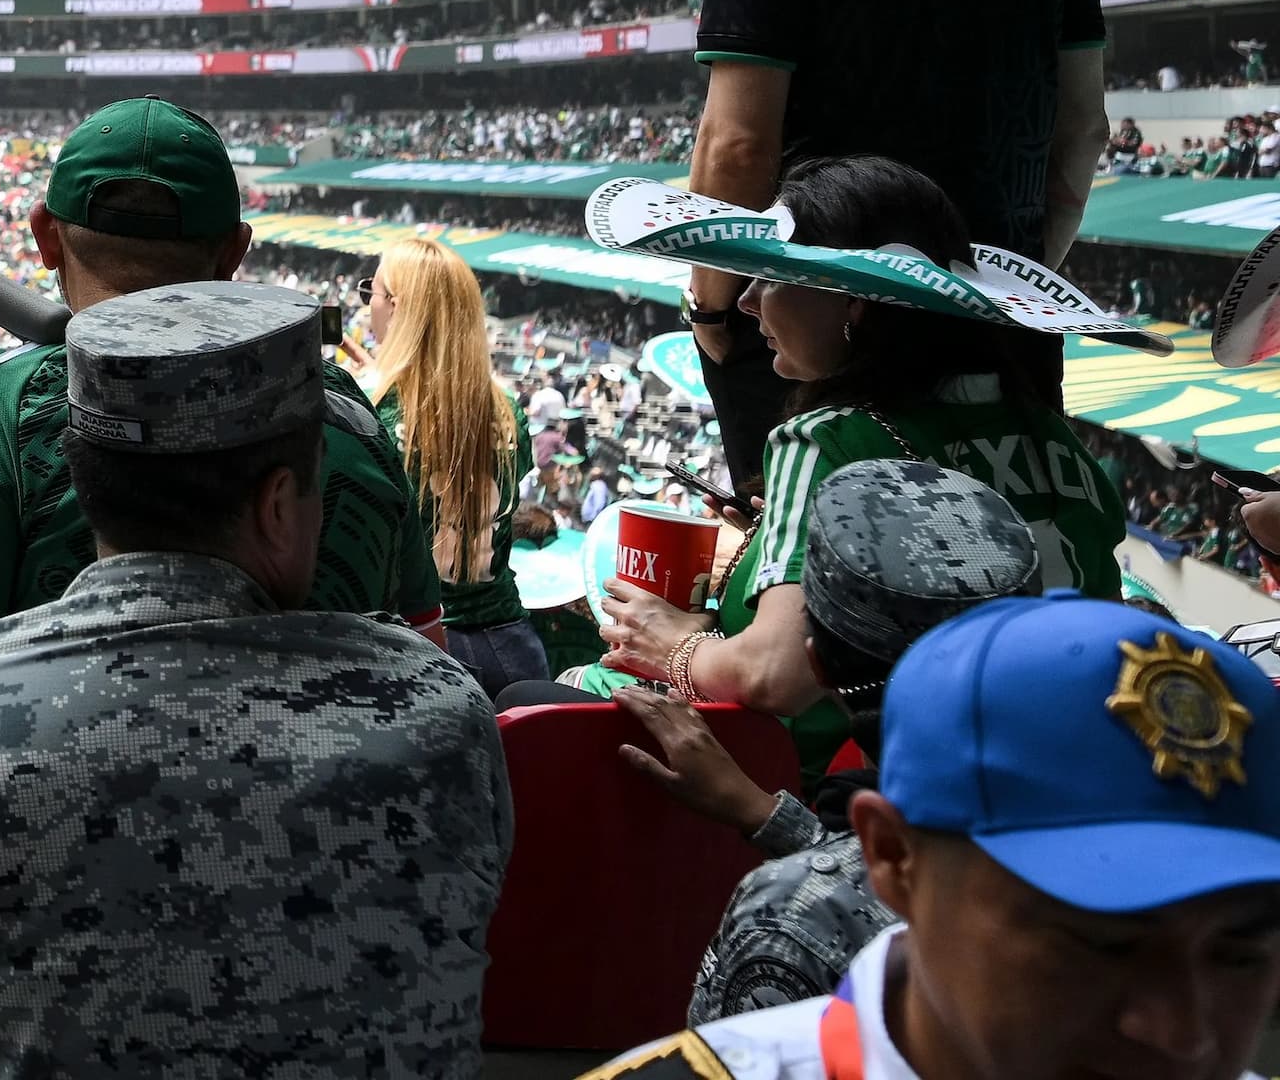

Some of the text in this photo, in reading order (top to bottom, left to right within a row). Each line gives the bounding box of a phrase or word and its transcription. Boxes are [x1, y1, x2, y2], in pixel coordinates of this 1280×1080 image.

[730, 222, 781, 241] FIFA
[874, 253, 926, 280] FIFA
[977, 248, 1003, 269] FA
[925, 434, 1105, 514] EXICO
